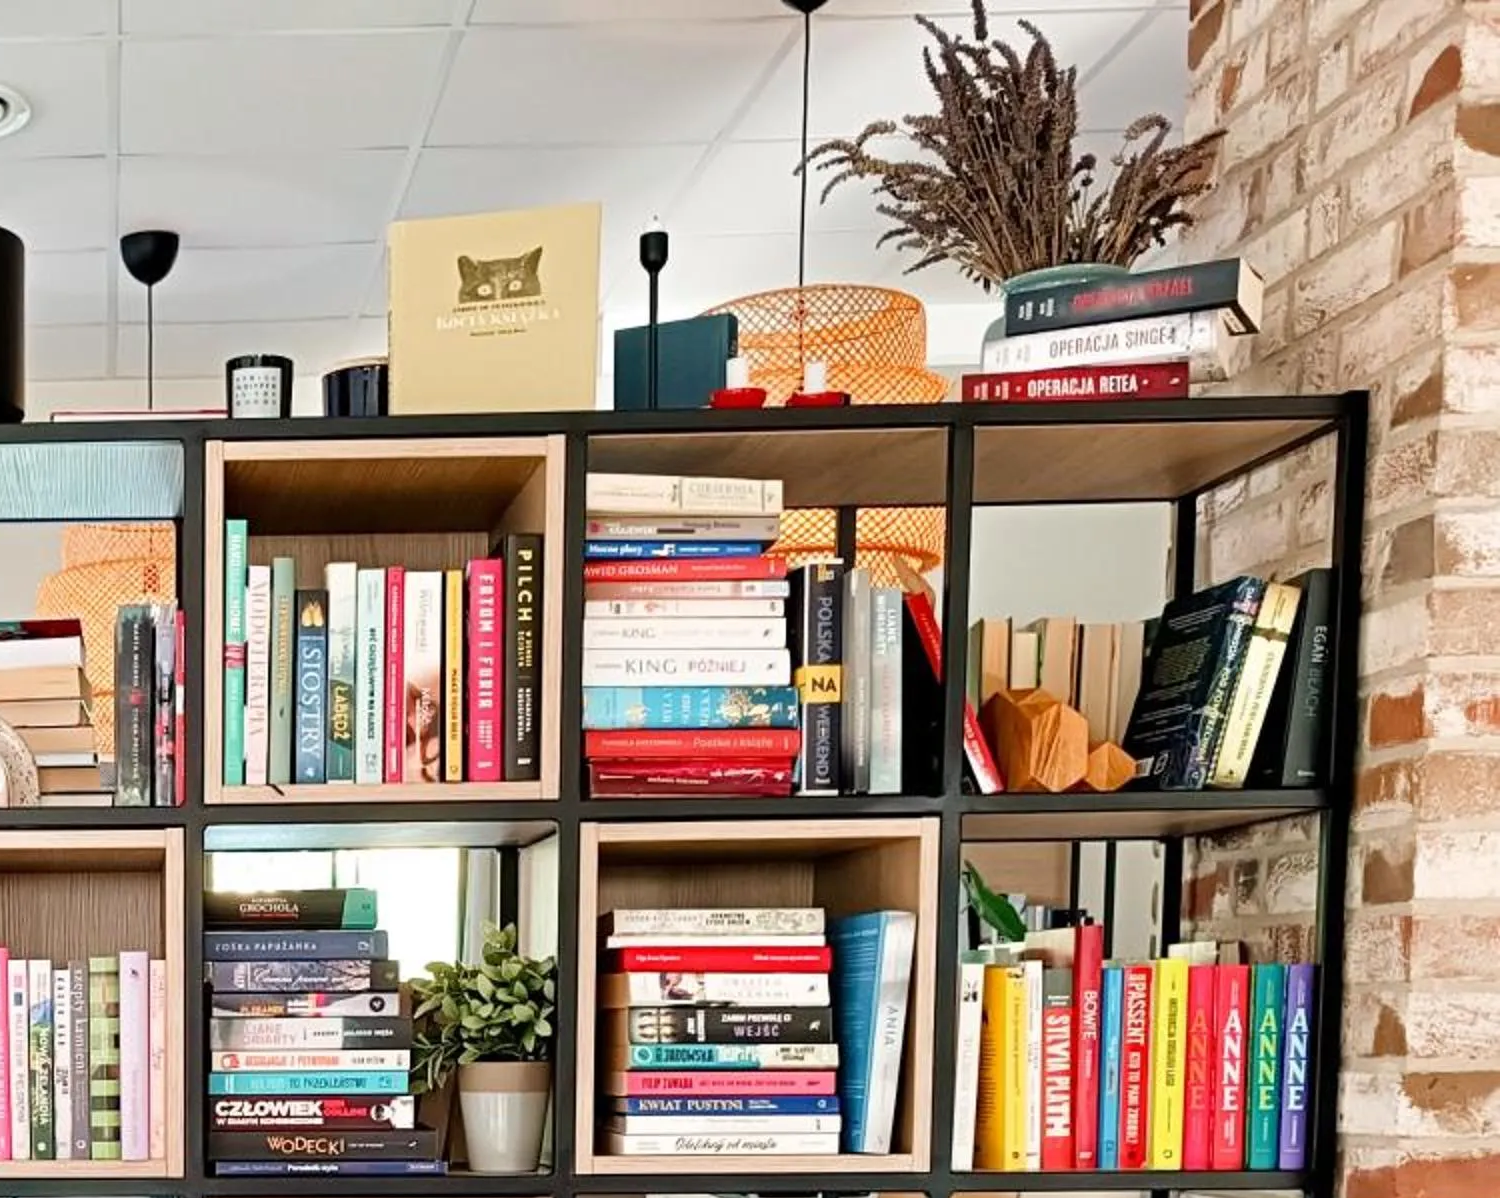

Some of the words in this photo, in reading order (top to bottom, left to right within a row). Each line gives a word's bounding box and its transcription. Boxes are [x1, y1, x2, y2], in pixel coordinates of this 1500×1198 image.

[1049, 331, 1119, 358] OPERACJA
[1027, 377, 1095, 398] OPERACJA
[517, 549, 533, 621] PILCH
[584, 565, 615, 578] AWID
[817, 596, 833, 663] POLSKA
[887, 609, 897, 643] LIANE
[1310, 625, 1328, 663] EGAN
[625, 657, 678, 675] KING
[811, 677, 837, 693] NA
[300, 645, 322, 759] SIOSTRY
[239, 903, 299, 914] GROCHOLA
[734, 1023, 781, 1038] WEJŚĆ
[884, 1004, 899, 1046] ANIA
[1081, 989, 1098, 1041] BOWIE
[1125, 984, 1146, 1045] PASSENT
[1045, 1014, 1070, 1073] SYLVIA
[1189, 1008, 1210, 1110] ANNE
[1221, 1006, 1242, 1112] ANNE
[1258, 1007, 1278, 1111] ANNE
[1287, 1007, 1310, 1112] ANNE
[215, 1100, 323, 1117] CZŁOWIEK
[638, 1099, 682, 1111] KWIAT
[687, 1099, 743, 1111] PUSTYNI
[1045, 1076, 1070, 1138] PLATH
[267, 1135, 345, 1156] WODECKI
